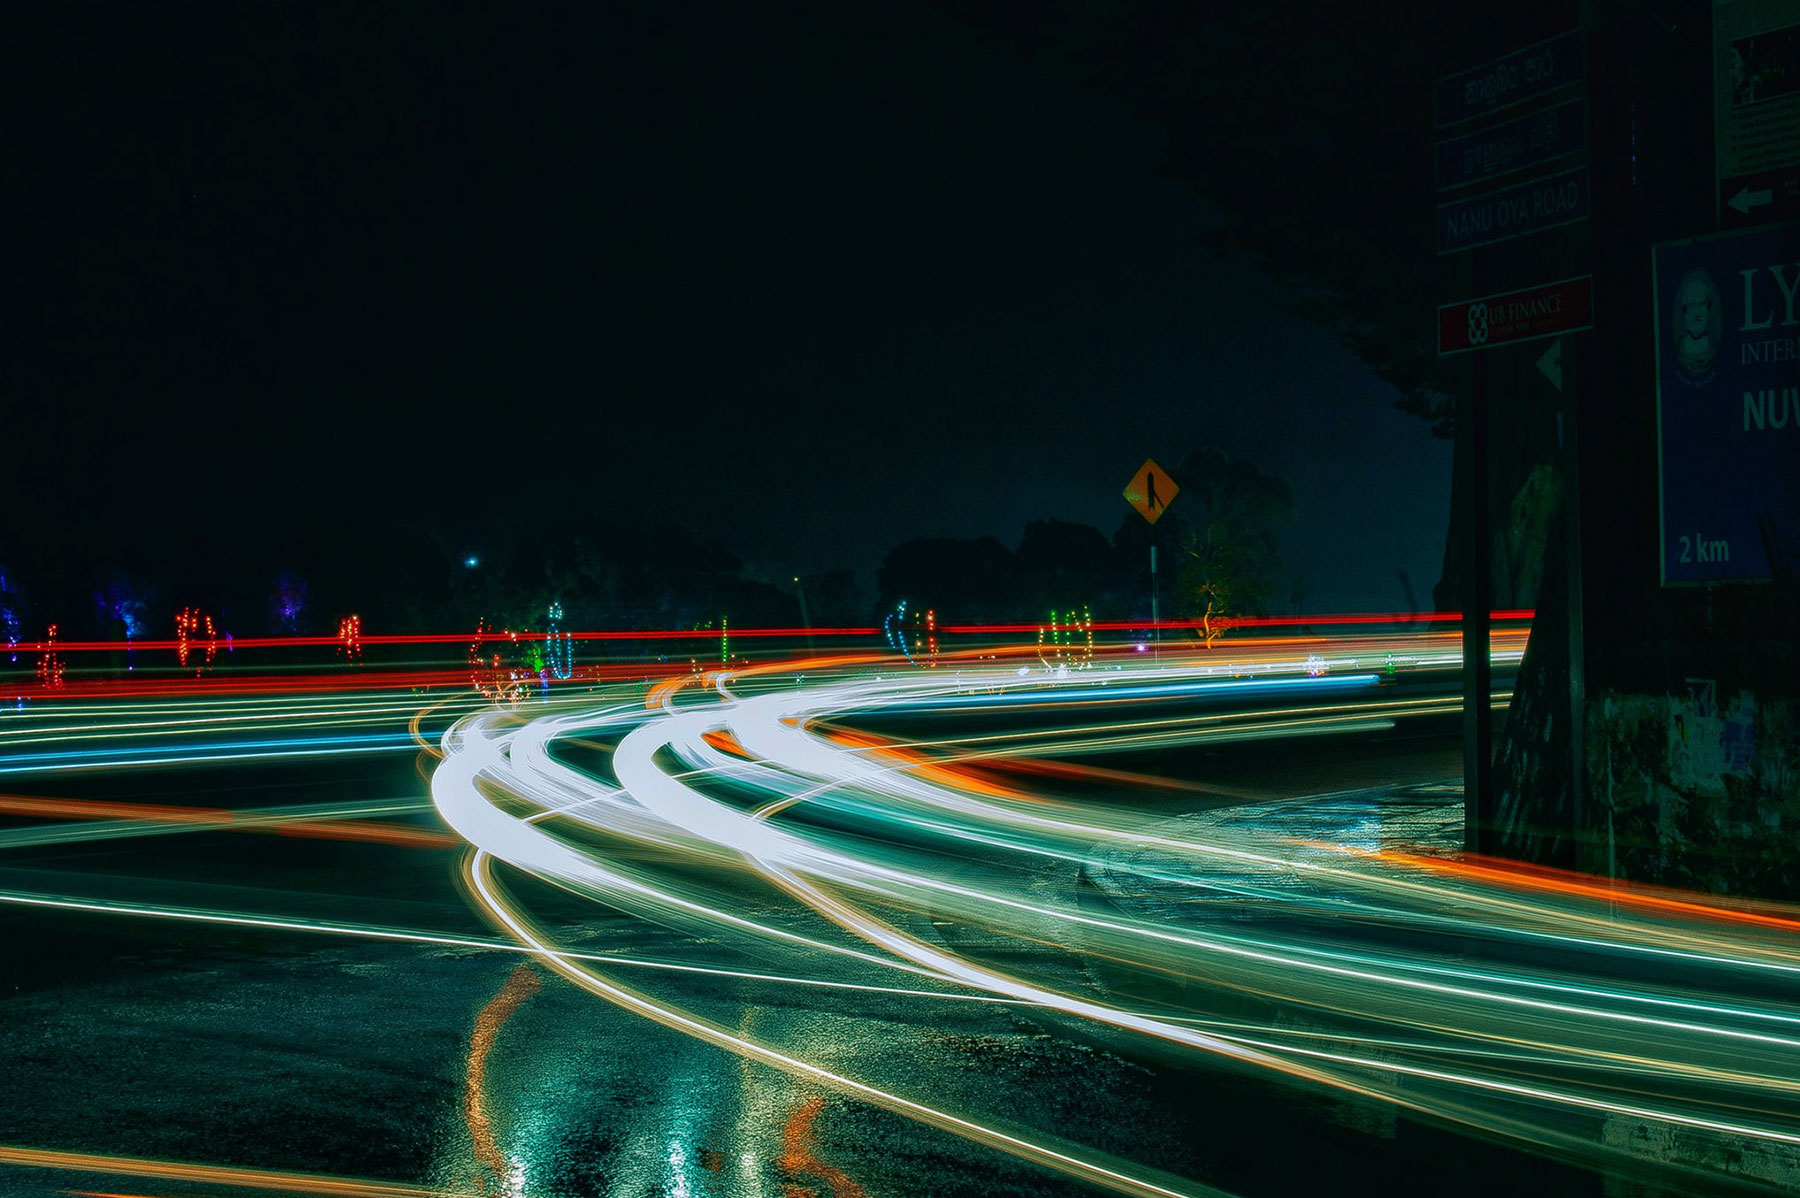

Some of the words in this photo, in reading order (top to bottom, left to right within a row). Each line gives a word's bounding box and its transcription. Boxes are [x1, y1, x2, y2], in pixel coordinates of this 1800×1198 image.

[1447, 203, 1493, 241] NANU
[1497, 195, 1530, 228] OYA
[1534, 181, 1579, 217] ROAD
[1488, 304, 1505, 326] UB
[1509, 293, 1563, 322] FINANCE
[1740, 337, 1800, 366] INTER
[1679, 535, 1691, 564] 2
[1697, 533, 1730, 563] km
